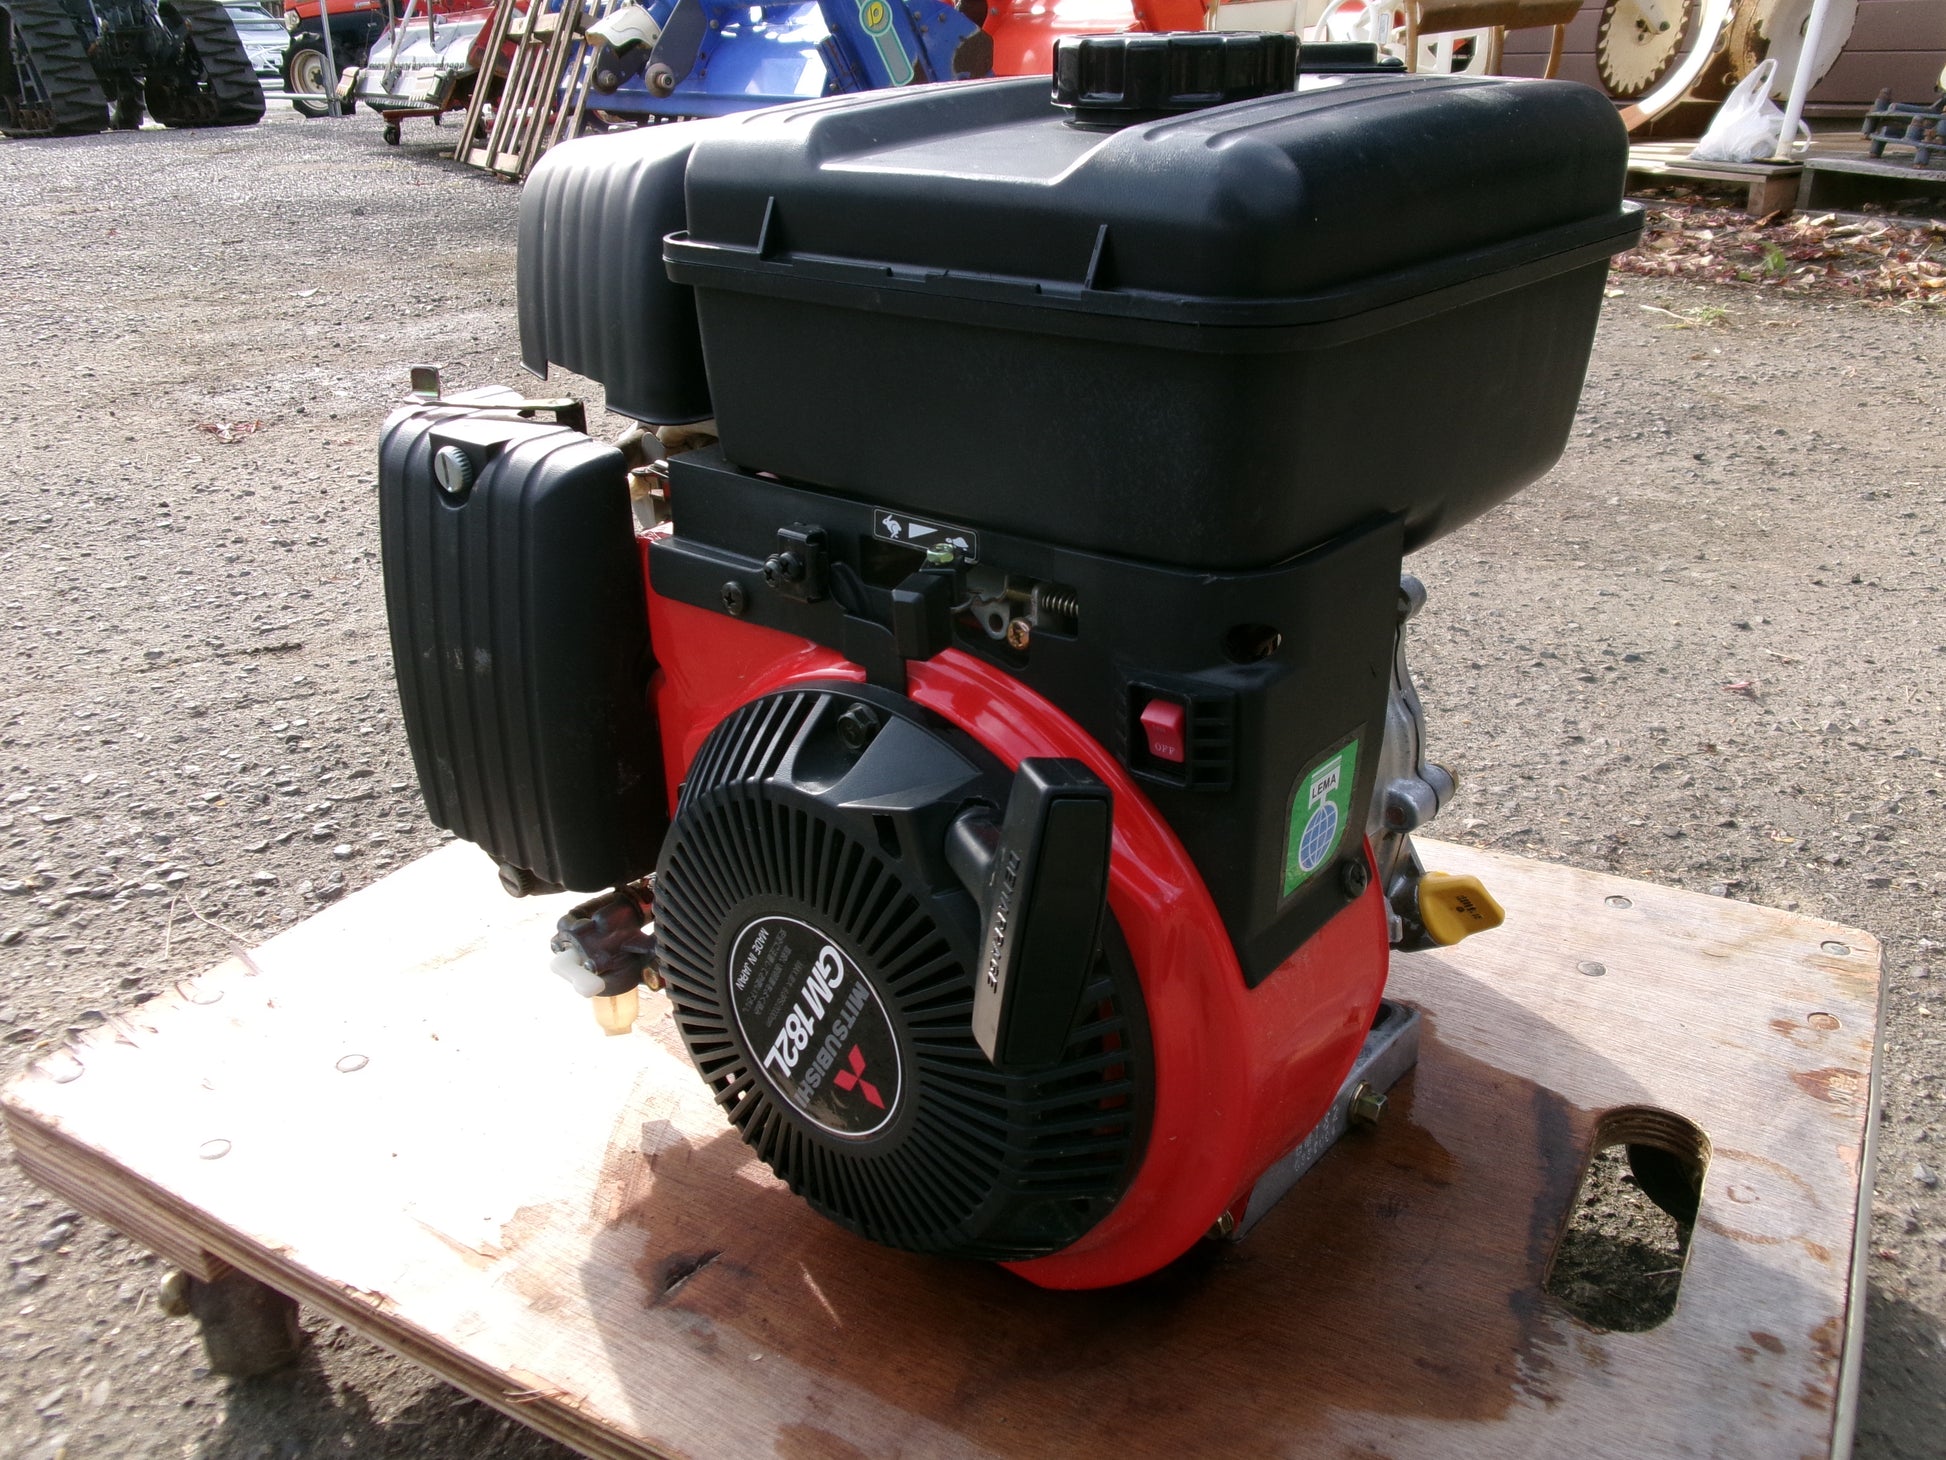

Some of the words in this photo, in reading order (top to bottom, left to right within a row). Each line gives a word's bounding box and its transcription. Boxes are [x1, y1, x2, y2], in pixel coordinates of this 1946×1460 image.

[1154, 743, 1175, 755] OFF
[1312, 773, 1337, 799] LEMA
[751, 927, 770, 956] MADE
[747, 952, 758, 966] IN
[735, 962, 753, 991] JAPAN
[794, 981, 870, 1109] MITSUBISHI
